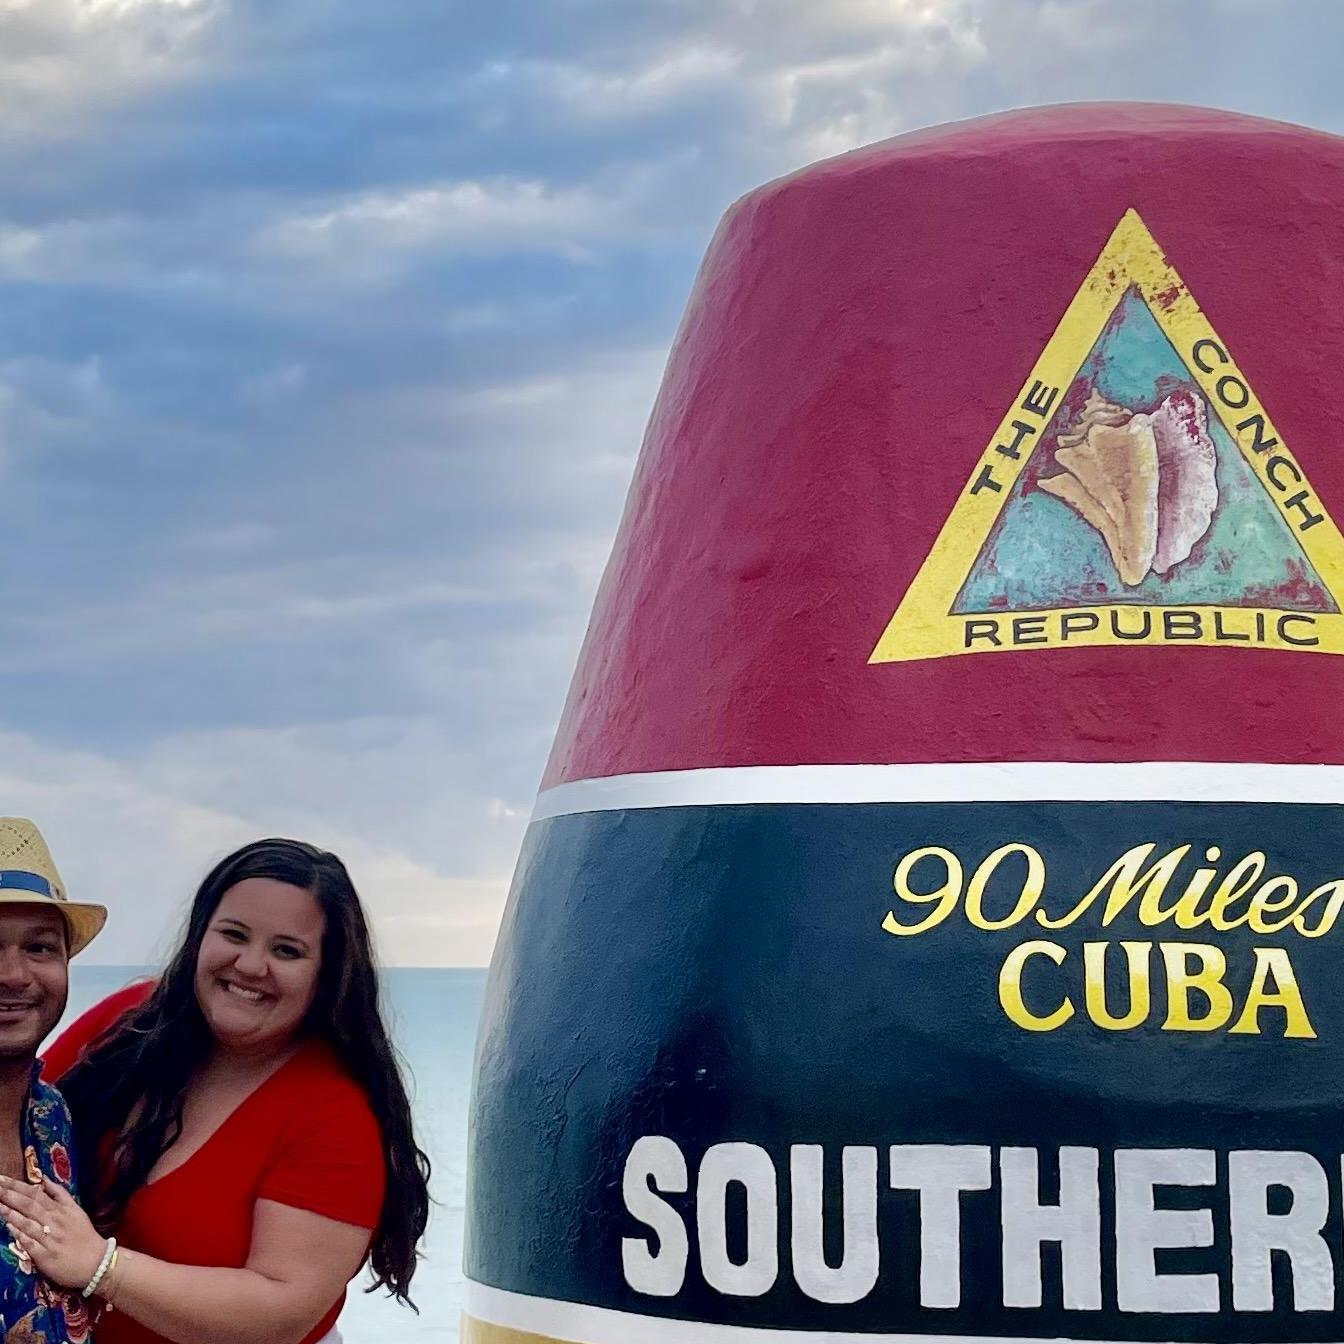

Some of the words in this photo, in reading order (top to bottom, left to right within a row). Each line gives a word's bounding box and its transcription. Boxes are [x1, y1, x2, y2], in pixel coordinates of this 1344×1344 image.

[971, 380, 1059, 497] THE
[1192, 339, 1325, 532] CONCH
[963, 609, 1320, 648] REPUBLIC
[880, 842, 1046, 936] 90
[997, 940, 1318, 1039] CUBA
